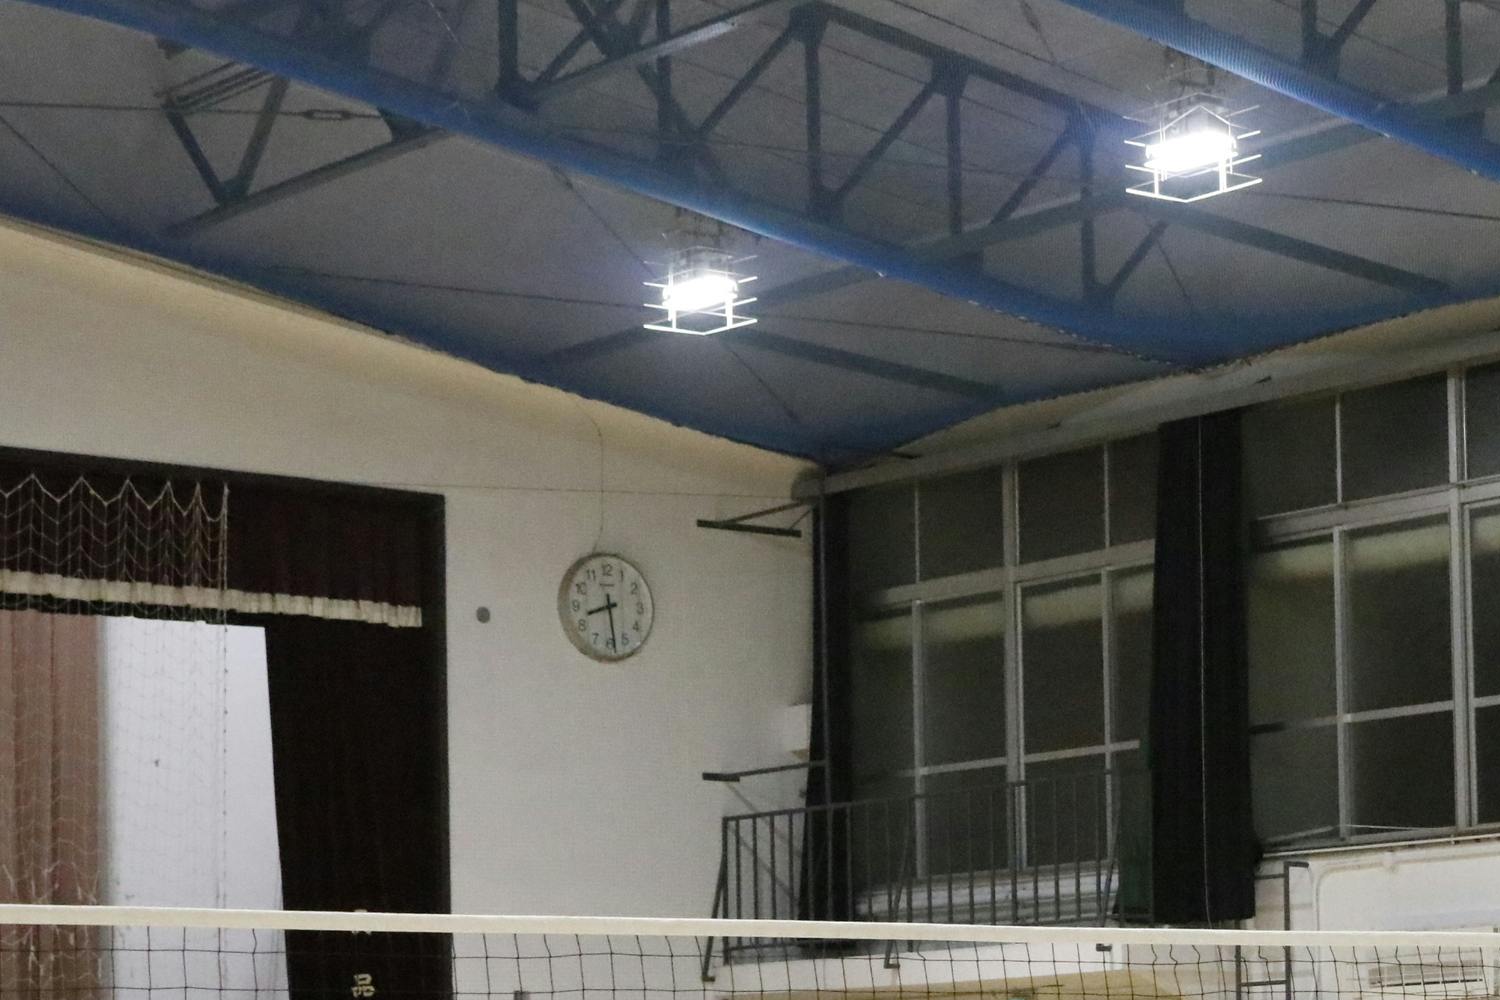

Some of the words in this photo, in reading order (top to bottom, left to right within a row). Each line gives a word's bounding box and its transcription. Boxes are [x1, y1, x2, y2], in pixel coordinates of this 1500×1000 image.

[586, 569, 597, 582] 11
[600, 563, 613, 577] 12
[630, 582, 639, 595] 2
[571, 600, 581, 613] 9
[635, 601, 645, 615] 3
[577, 618, 587, 633] 8
[632, 621, 640, 632] 4
[591, 632, 600, 646] 7
[621, 633, 631, 646] 5
